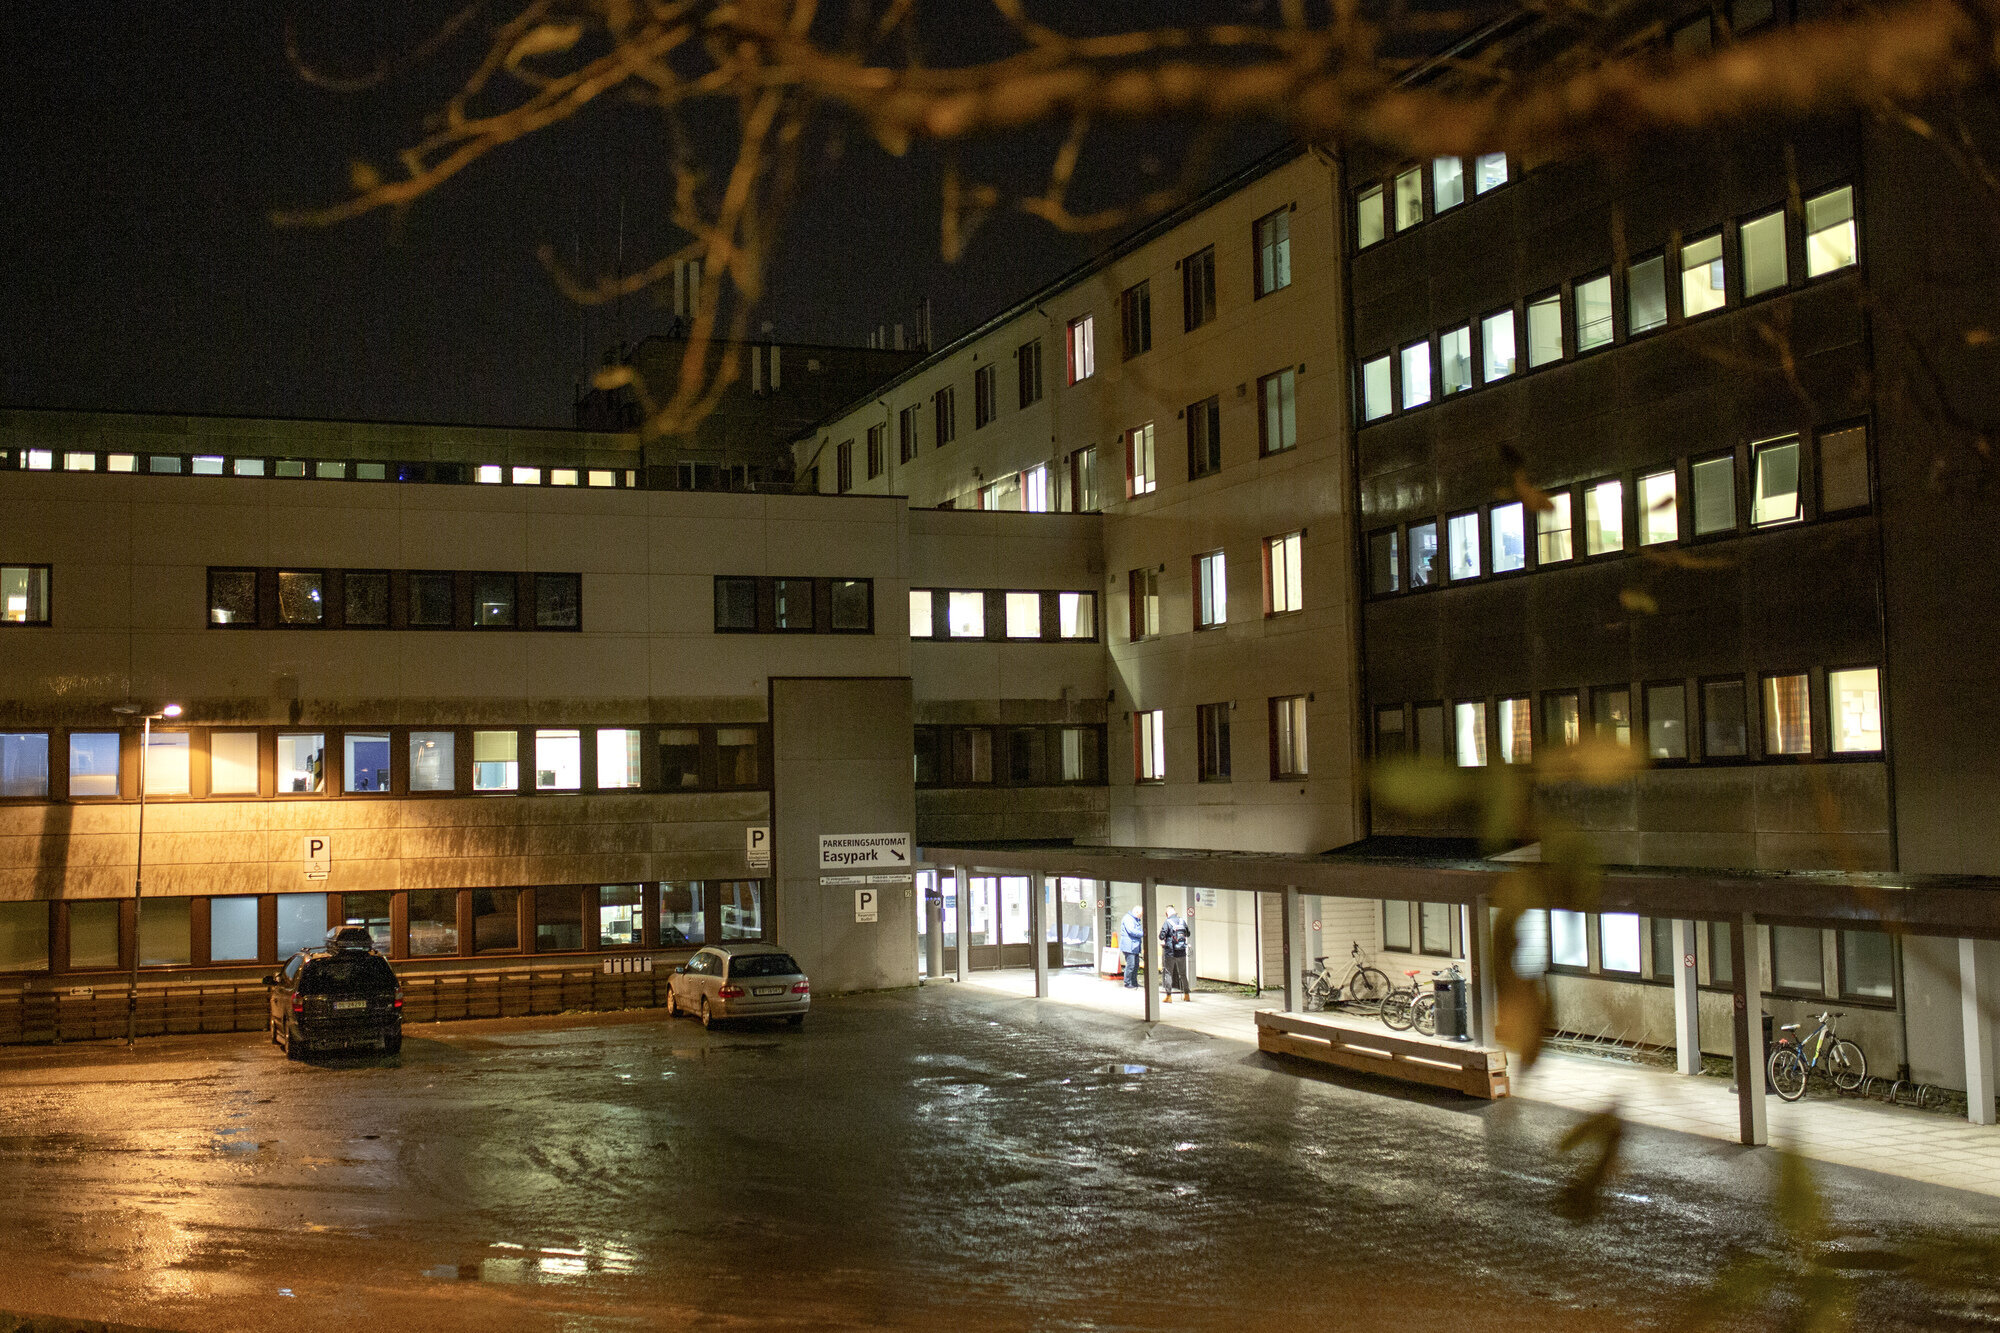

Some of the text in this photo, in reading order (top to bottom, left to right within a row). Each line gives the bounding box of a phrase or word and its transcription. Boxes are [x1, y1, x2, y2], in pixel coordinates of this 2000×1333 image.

[752, 830, 764, 848] P
[822, 837, 907, 848] PARKERINGSAUTOMAT
[310, 839, 324, 859] P
[823, 849, 878, 865] Easypark
[860, 892, 872, 910] P
